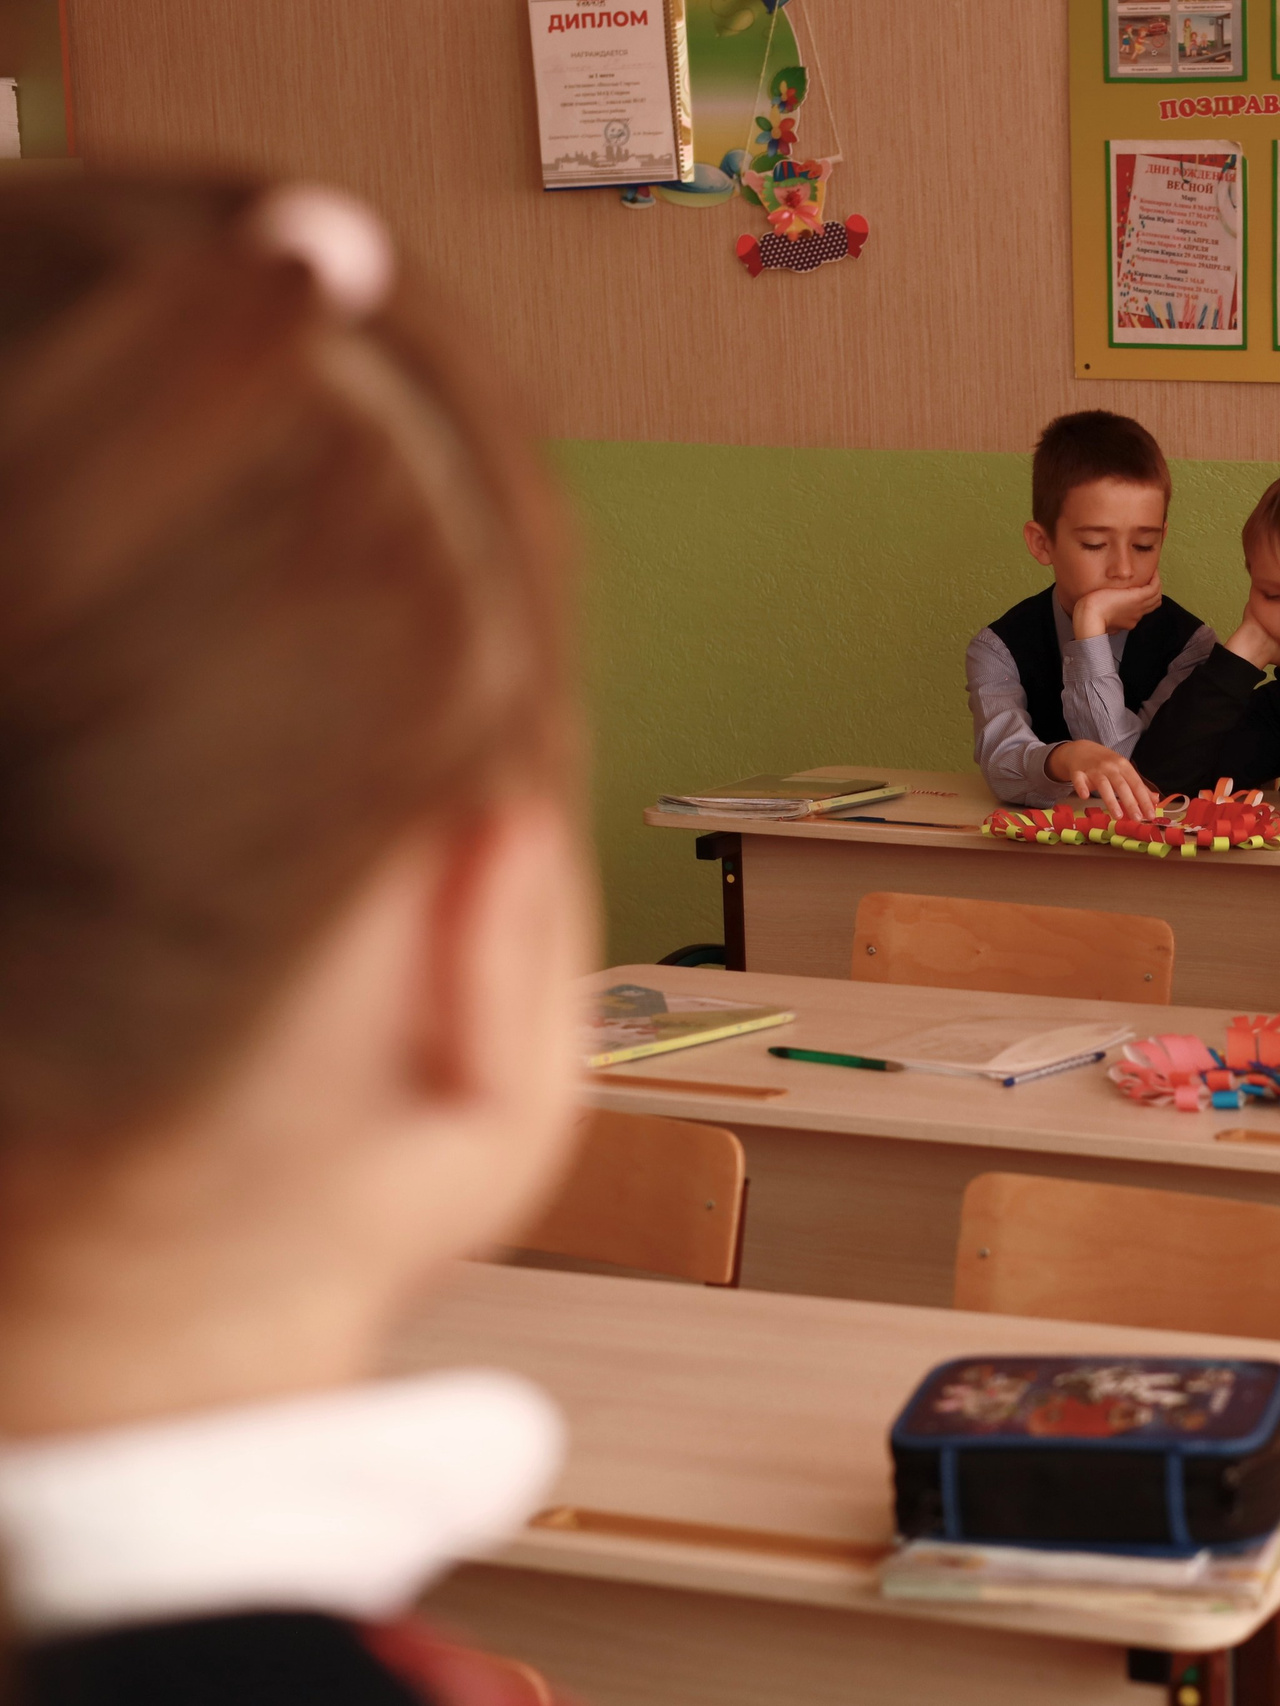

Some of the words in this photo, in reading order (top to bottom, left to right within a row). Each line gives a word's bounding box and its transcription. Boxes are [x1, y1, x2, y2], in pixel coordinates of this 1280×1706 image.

[548, 10, 648, 33] ДИПЛОМ
[571, 49, 628, 58] НАГРАЖДАЕТСЯ
[1145, 164, 1170, 175] ДНИ
[1166, 180, 1214, 194] ВЕСНОЙ
